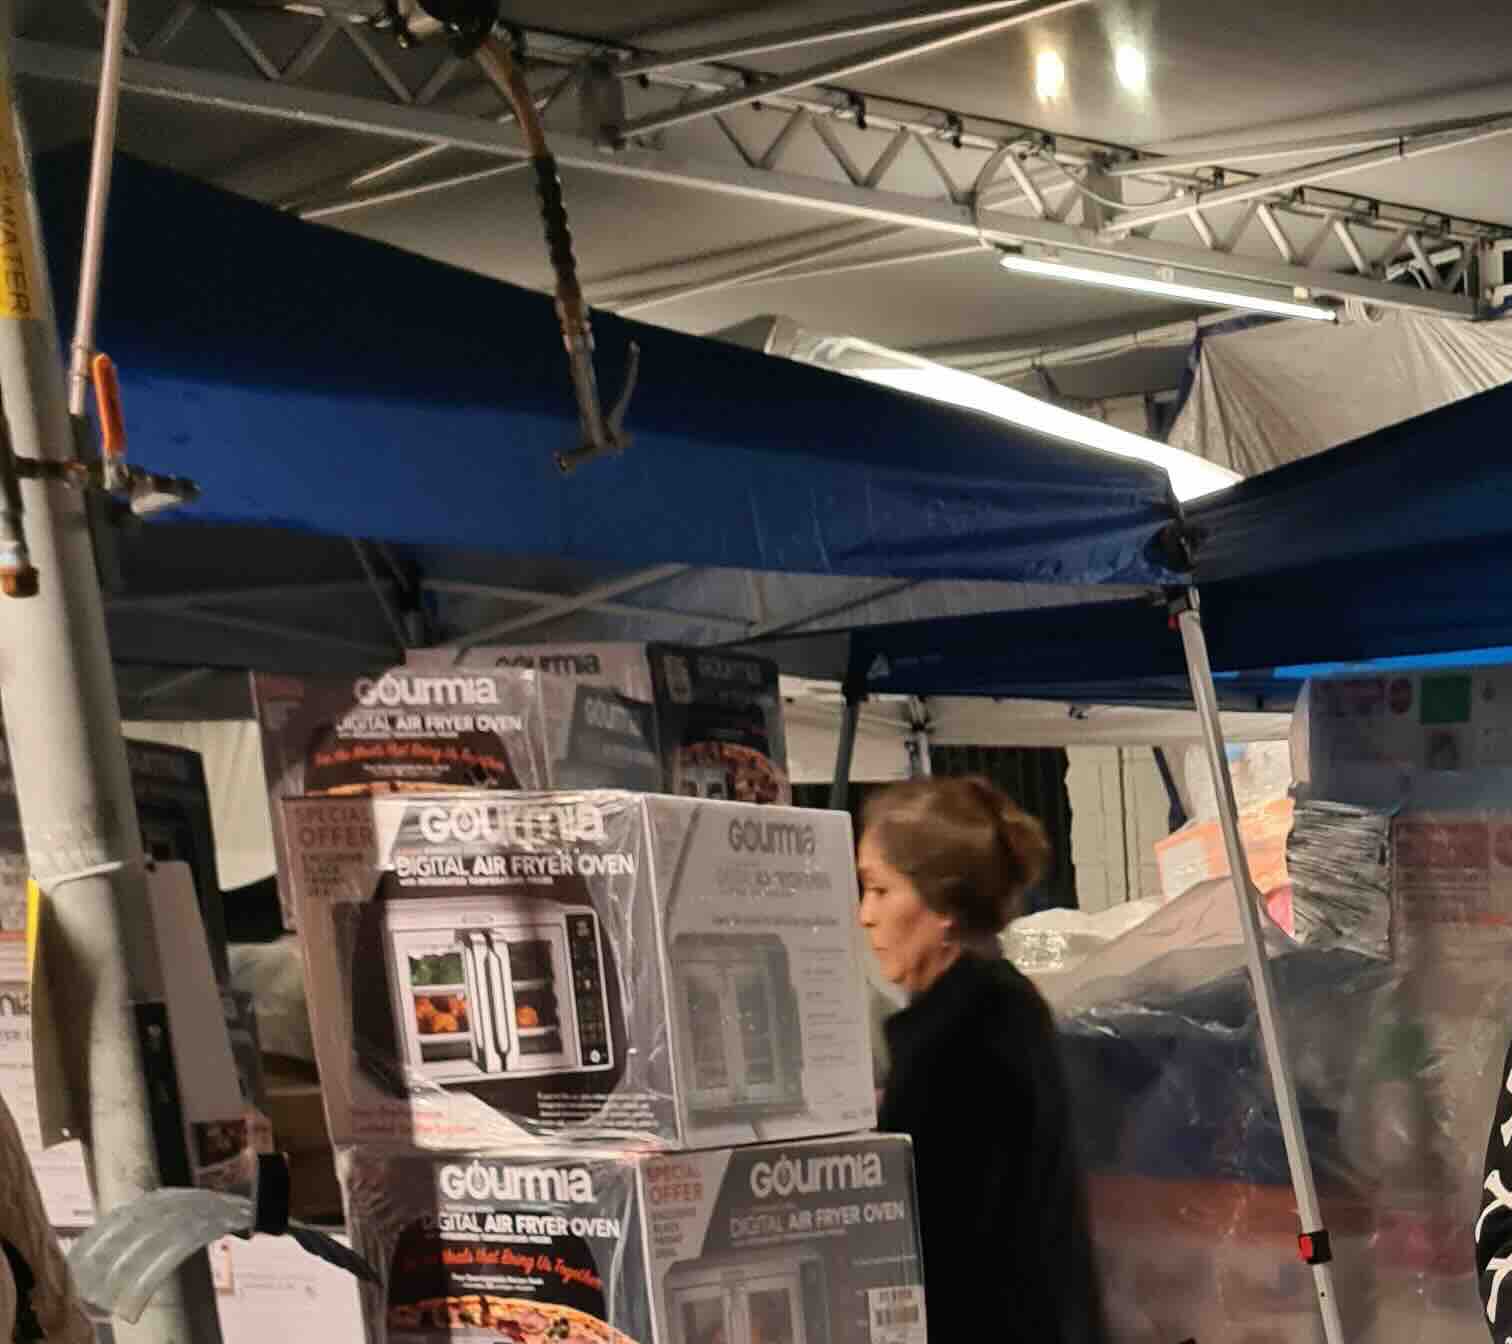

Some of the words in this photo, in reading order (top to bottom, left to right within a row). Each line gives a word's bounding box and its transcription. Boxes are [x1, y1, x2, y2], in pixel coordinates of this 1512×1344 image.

[473, 855, 507, 876] AIR
[511, 855, 574, 876] FRYER
[578, 854, 634, 875] OVEN
[484, 1214, 513, 1233] AIR
[515, 1215, 569, 1237] FRYER
[570, 1217, 621, 1239] OVEN
[788, 1211, 814, 1231] AIR
[815, 1205, 860, 1230] FRYER
[863, 1201, 905, 1223] OVEN
